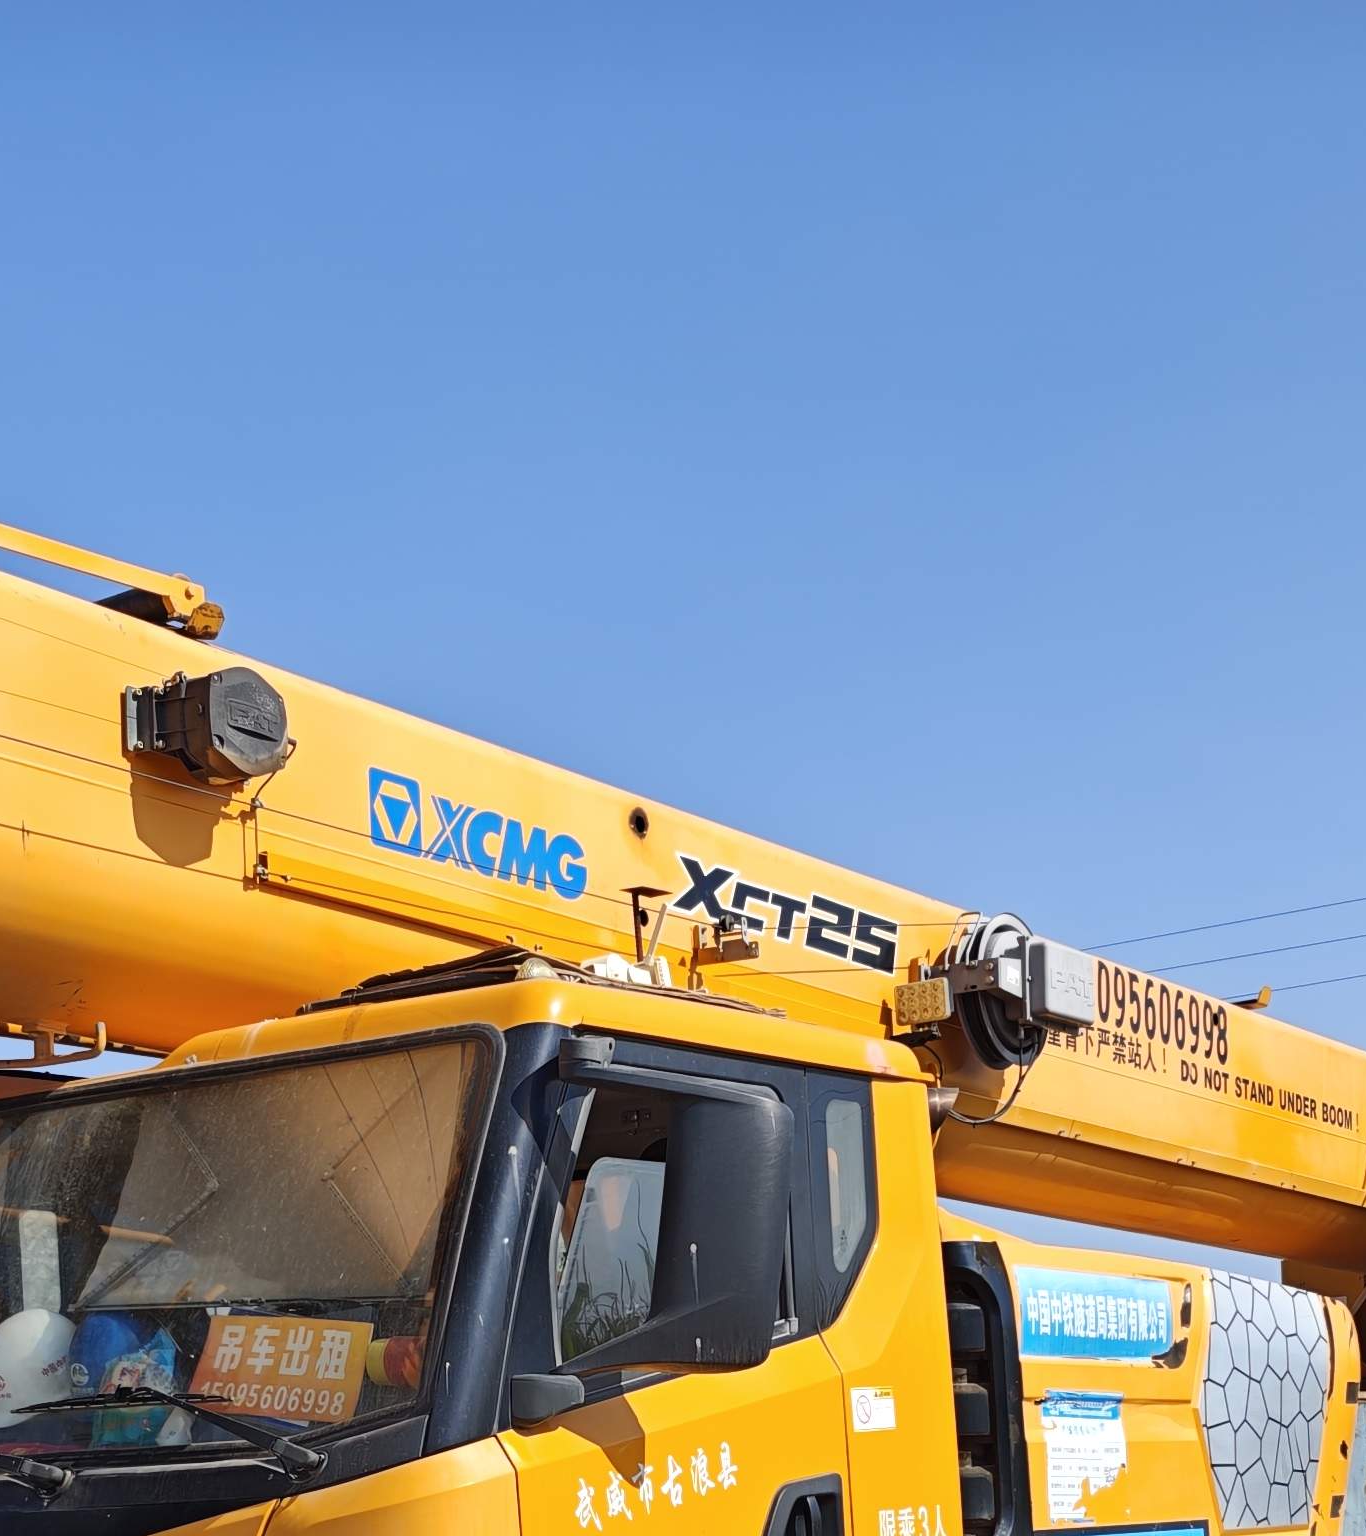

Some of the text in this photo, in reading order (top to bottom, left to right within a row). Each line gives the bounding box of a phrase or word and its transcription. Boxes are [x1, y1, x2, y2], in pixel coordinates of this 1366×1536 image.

[428, 795, 587, 899] XCMG
[673, 856, 898, 975] XCT25
[1181, 1060, 1198, 1085] DO
[1204, 1067, 1229, 1094] NOT
[1235, 1077, 1273, 1107] STAND
[1279, 1089, 1317, 1120] UNDER
[212, 1325, 352, 1380] 吊车出租
[1026, 1287, 1167, 1343] 中国中铁隧道局集团有限公司
[575, 1441, 739, 1532] 武威市古浪县
